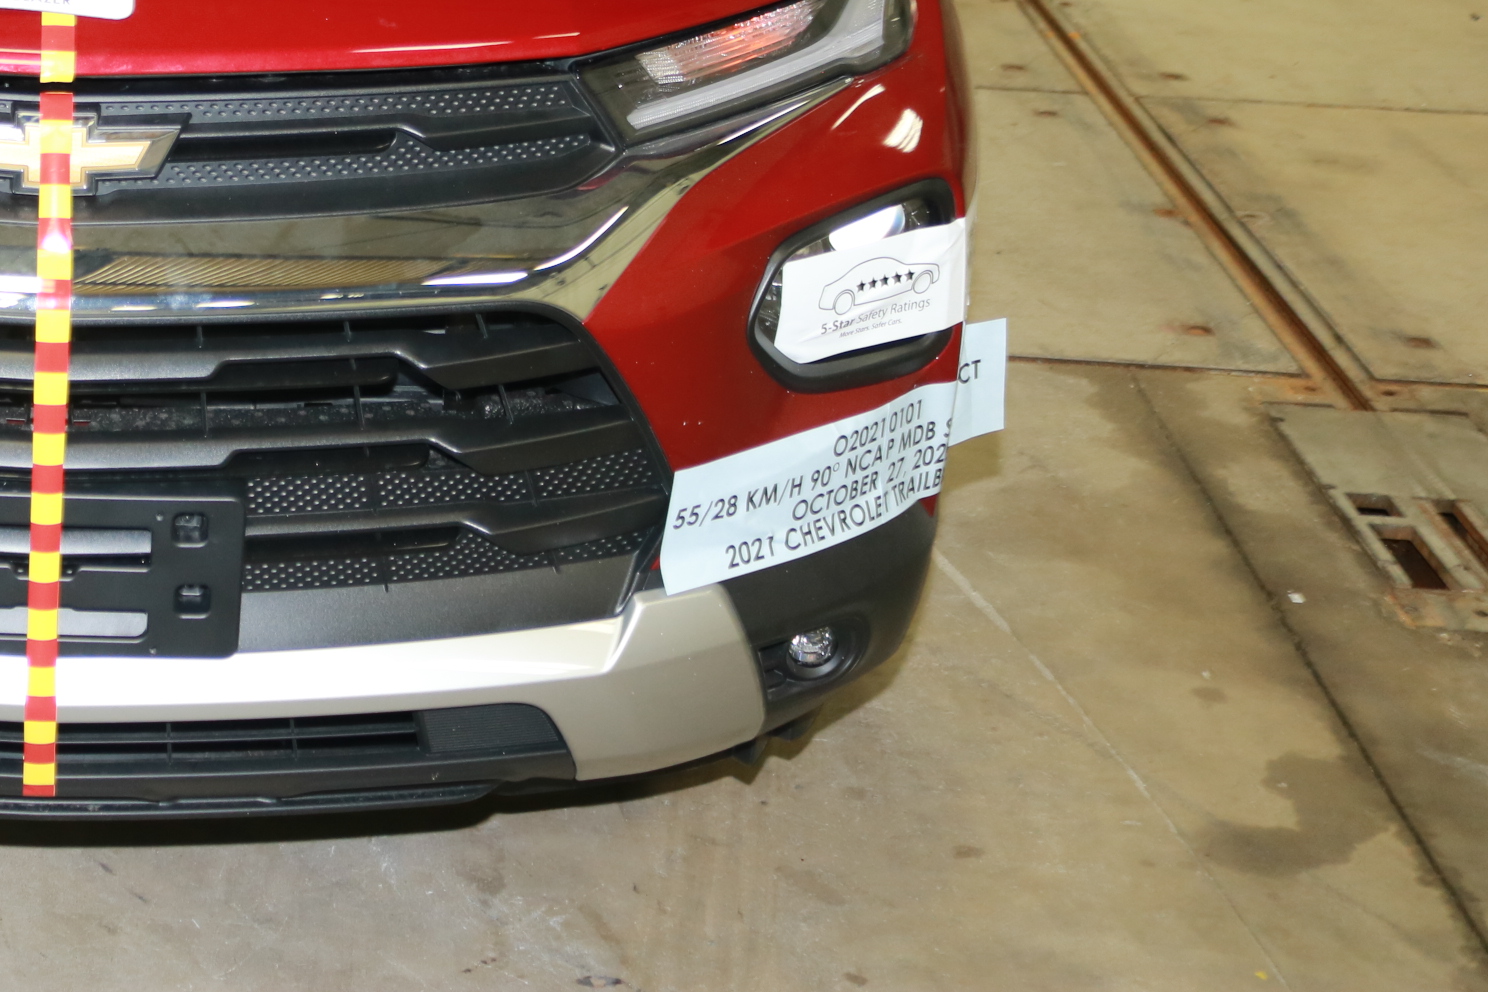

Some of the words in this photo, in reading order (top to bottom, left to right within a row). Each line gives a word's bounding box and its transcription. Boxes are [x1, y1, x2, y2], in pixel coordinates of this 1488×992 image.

[821, 318, 856, 335] 5-Star
[856, 307, 889, 324] Safety
[890, 298, 931, 315] Ratings
[839, 329, 854, 338] More
[871, 321, 887, 330] Safer
[673, 495, 738, 530] 55/28
[746, 475, 803, 512] KM/H
[811, 462, 840, 491] 90°
[845, 438, 895, 479] NCAP
[898, 421, 936, 454] MDB
[792, 471, 879, 521] OCTOBER
[886, 456, 907, 484] 27,
[725, 536, 774, 569] 2021
[784, 491, 889, 551] CHEVROLET
[891, 468, 943, 506] TRAILB
